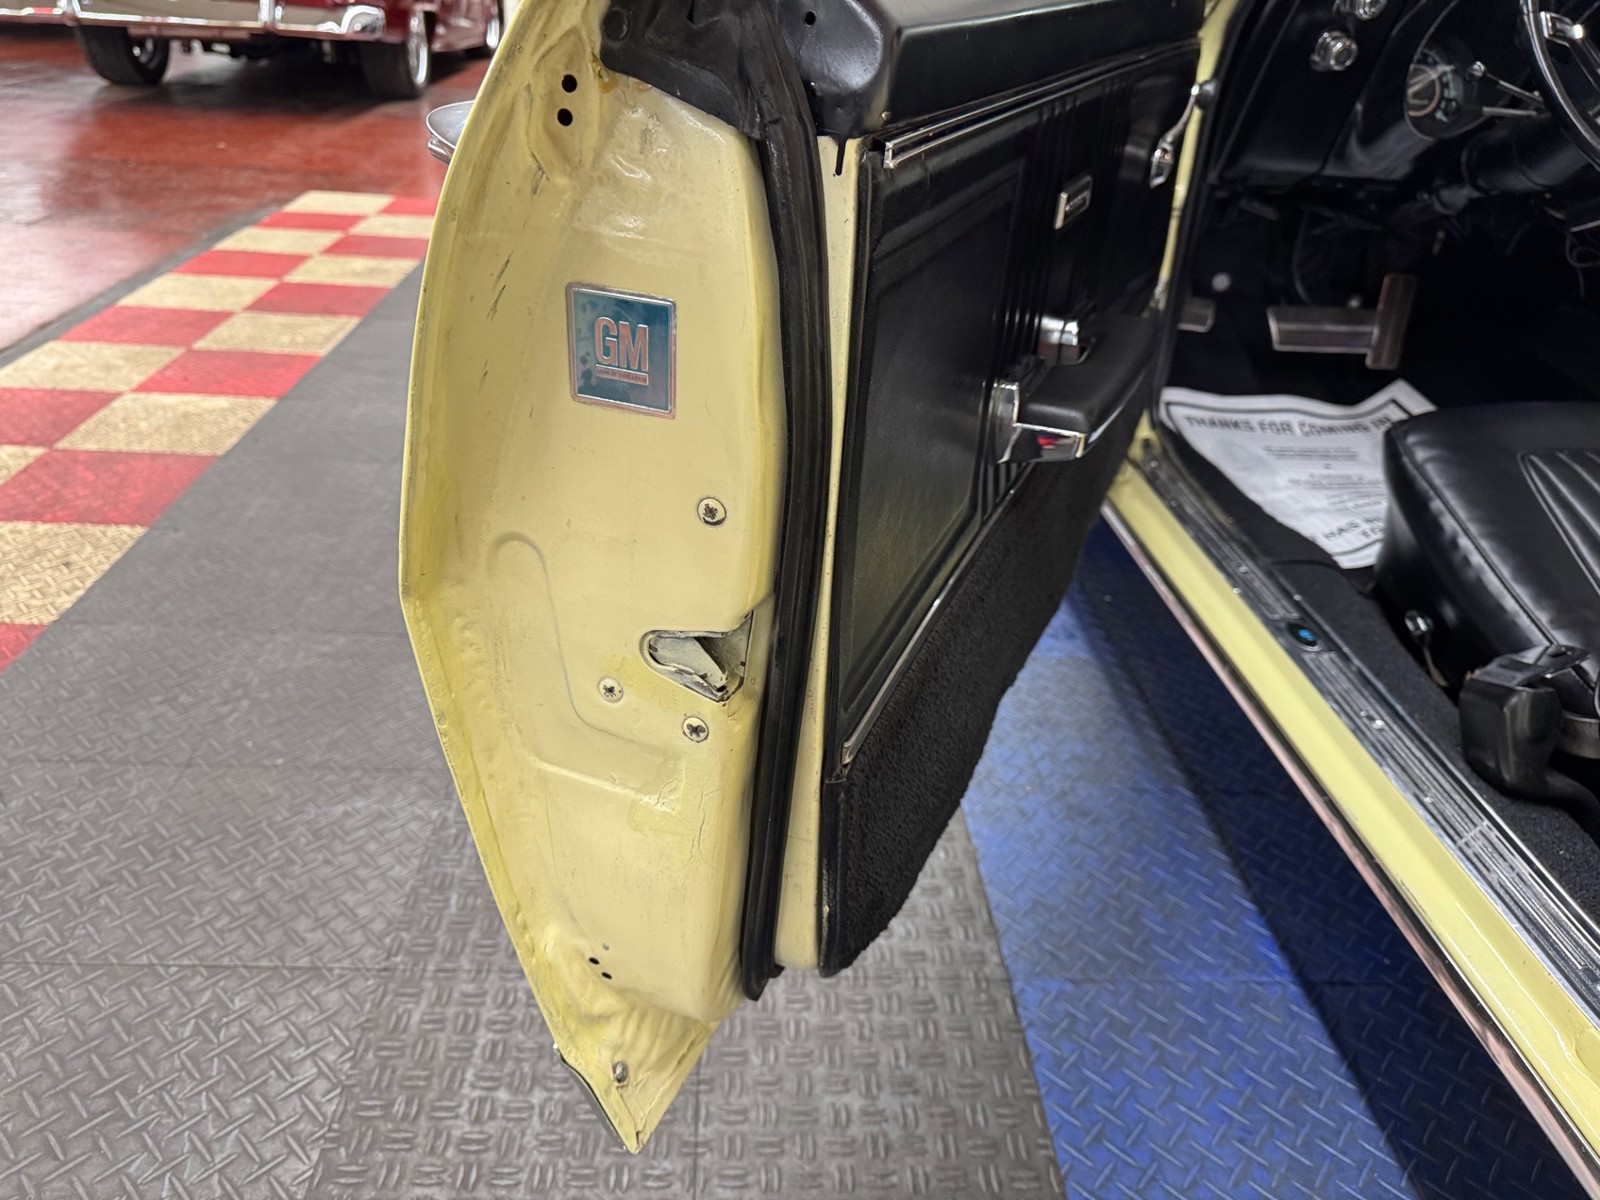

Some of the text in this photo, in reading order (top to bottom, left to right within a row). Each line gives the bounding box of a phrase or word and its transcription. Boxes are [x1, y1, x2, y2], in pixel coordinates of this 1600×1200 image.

[594, 316, 649, 372] GM
[1185, 415, 1256, 433] THANKS
[1257, 419, 1296, 436] FOR
[1298, 418, 1370, 437] COMING
